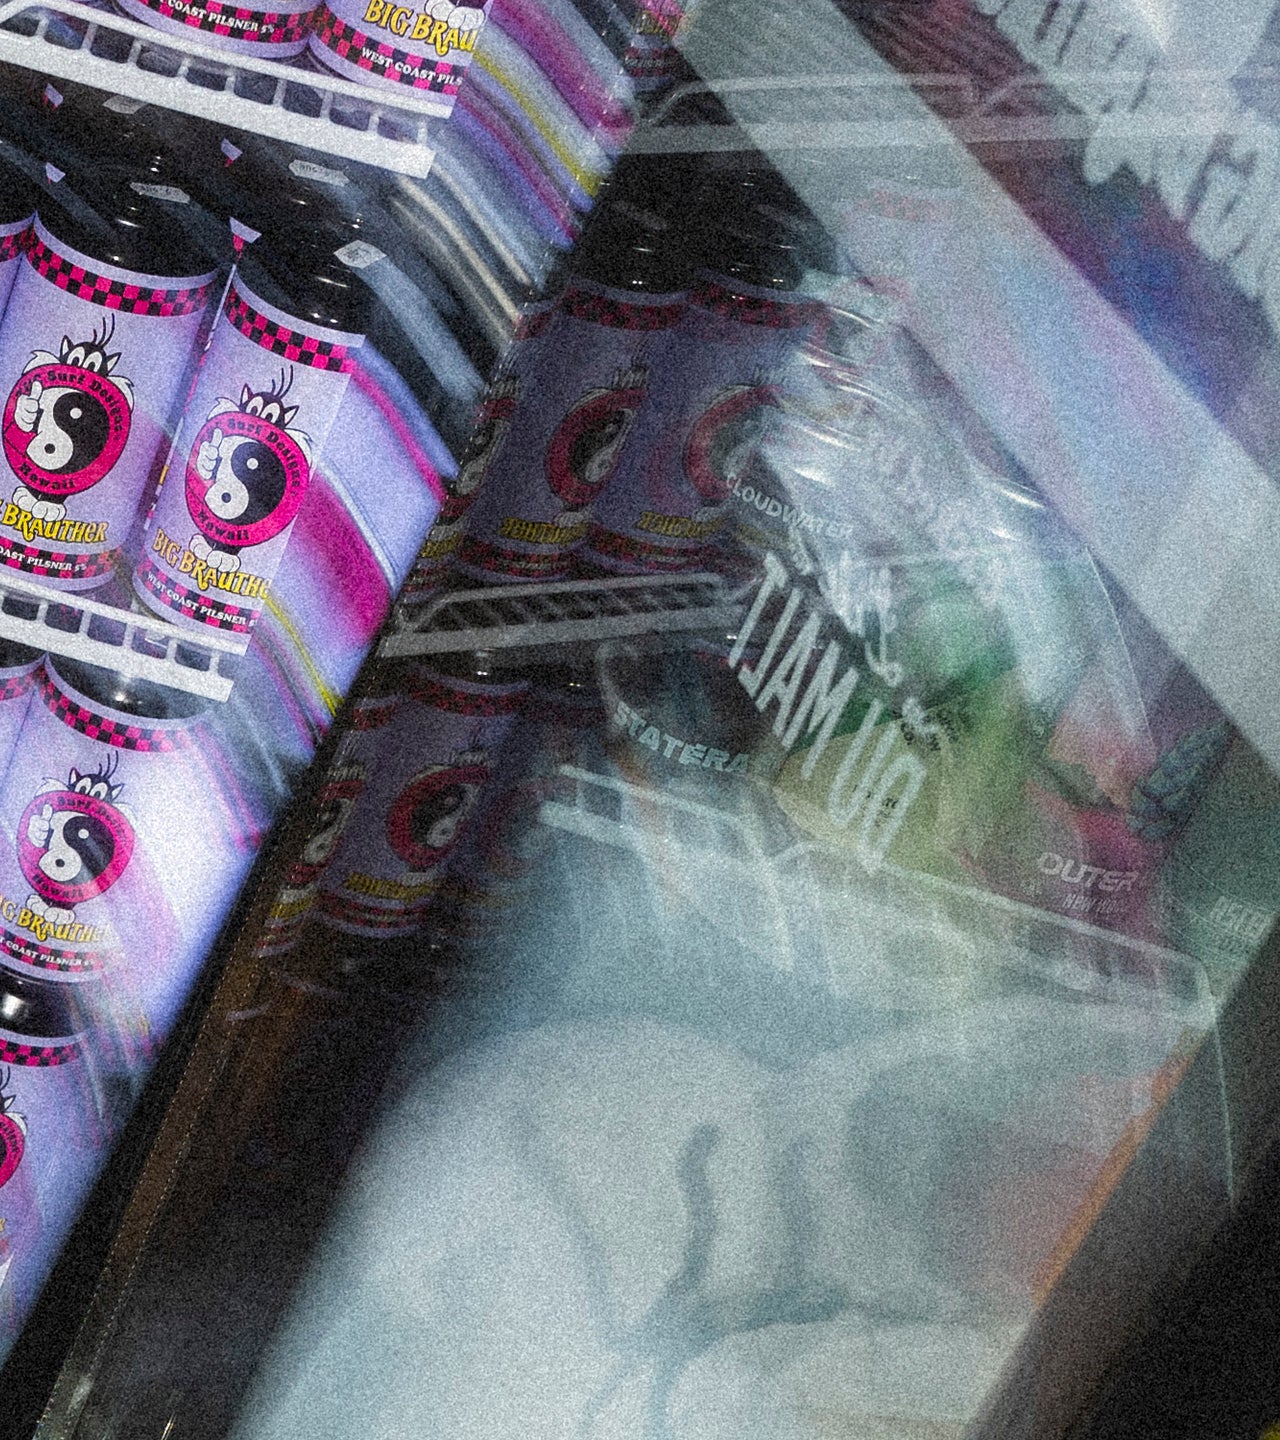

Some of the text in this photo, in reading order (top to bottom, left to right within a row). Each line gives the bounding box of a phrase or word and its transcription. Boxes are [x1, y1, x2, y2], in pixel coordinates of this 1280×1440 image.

[207, 9, 260, 34] PILSNER
[411, 11, 480, 58] BRAU
[360, 45, 466, 87] WEST COAST PILS
[46, 369, 87, 386] Surf
[19, 460, 76, 491] Hawaii
[2, 501, 110, 544] BRAUTHER
[26, 552, 73, 573] PILSNER
[151, 525, 273, 601] BIG BRAUTHE
[167, 589, 199, 612] COAST
[200, 603, 247, 626] PILSNER
[15, 907, 104, 944] BRAUTH
